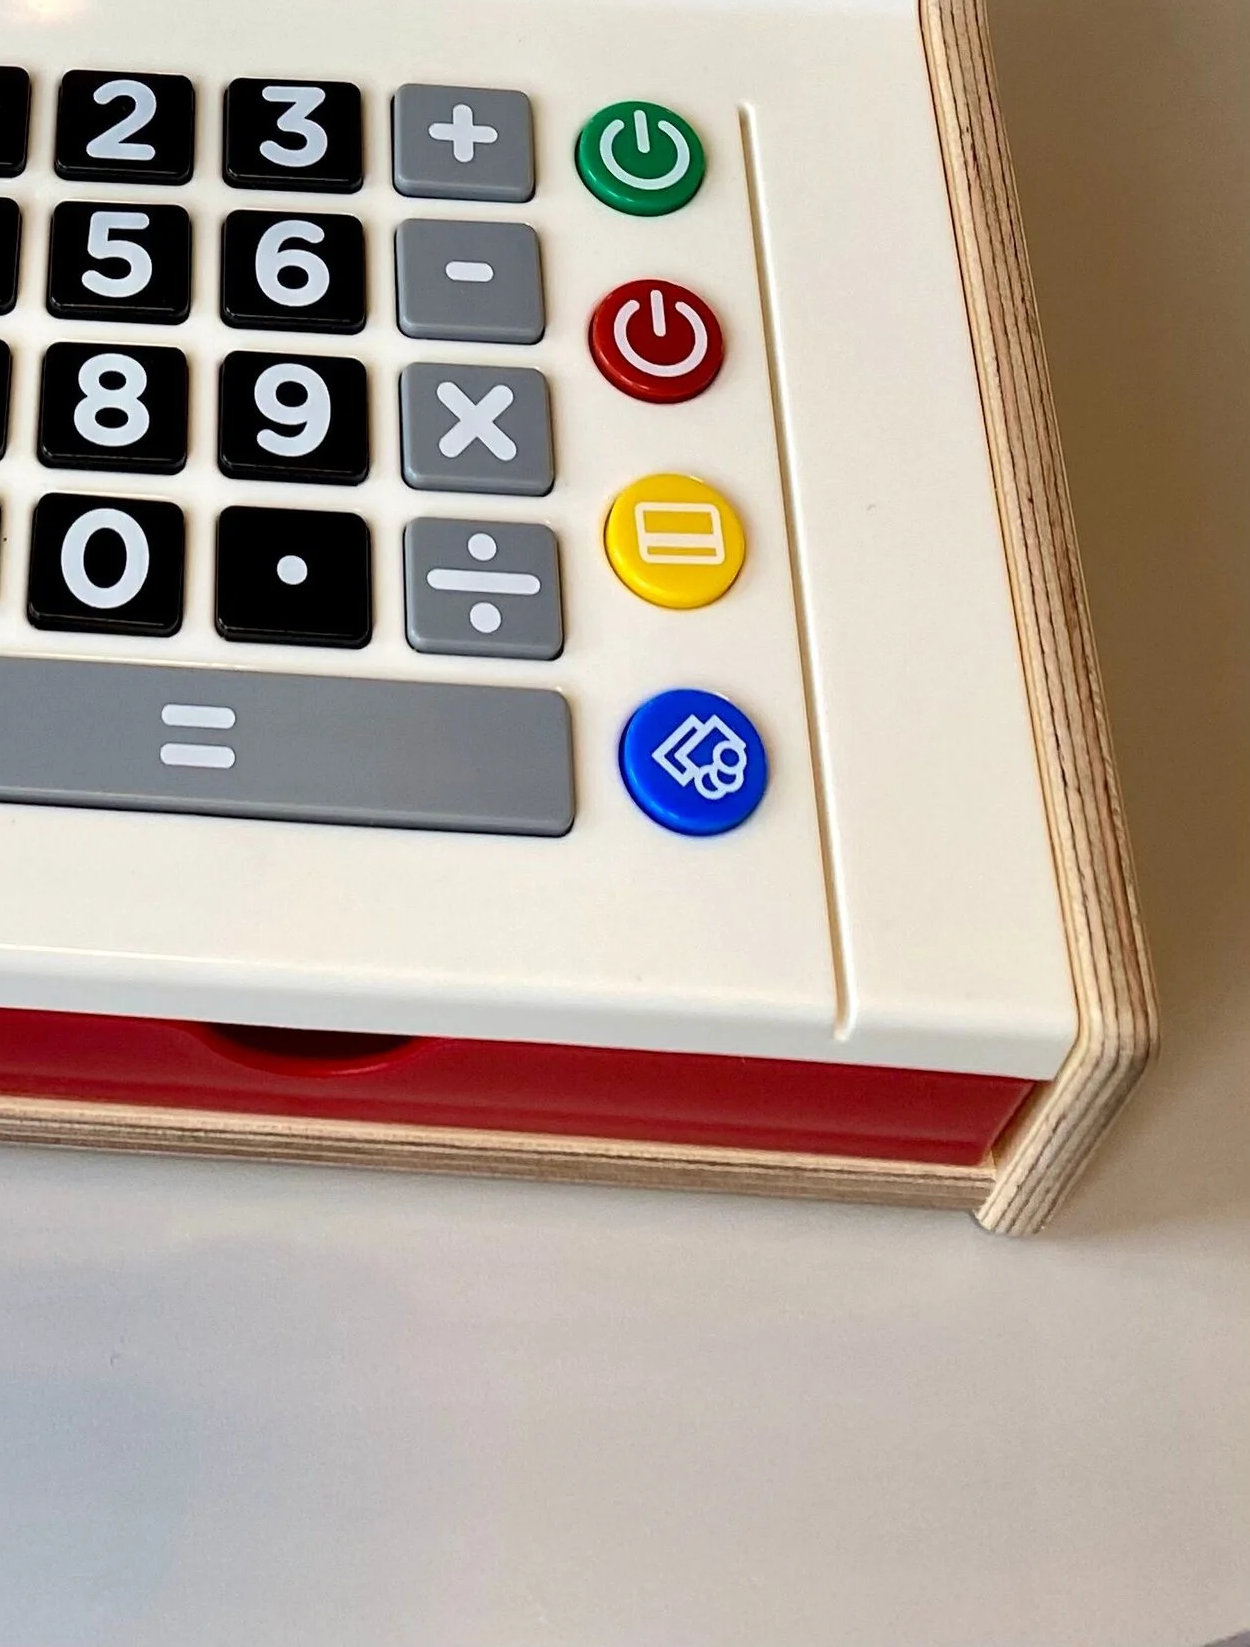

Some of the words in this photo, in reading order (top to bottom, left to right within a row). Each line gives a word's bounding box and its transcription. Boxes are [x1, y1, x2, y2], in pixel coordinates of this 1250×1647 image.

[85, 79, 157, 161] 2
[259, 85, 328, 168] 3
[81, 211, 153, 298] 5
[255, 219, 330, 307] 6
[73, 353, 150, 447] 8
[254, 363, 331, 457] 9
[60, 508, 150, 609] 0
